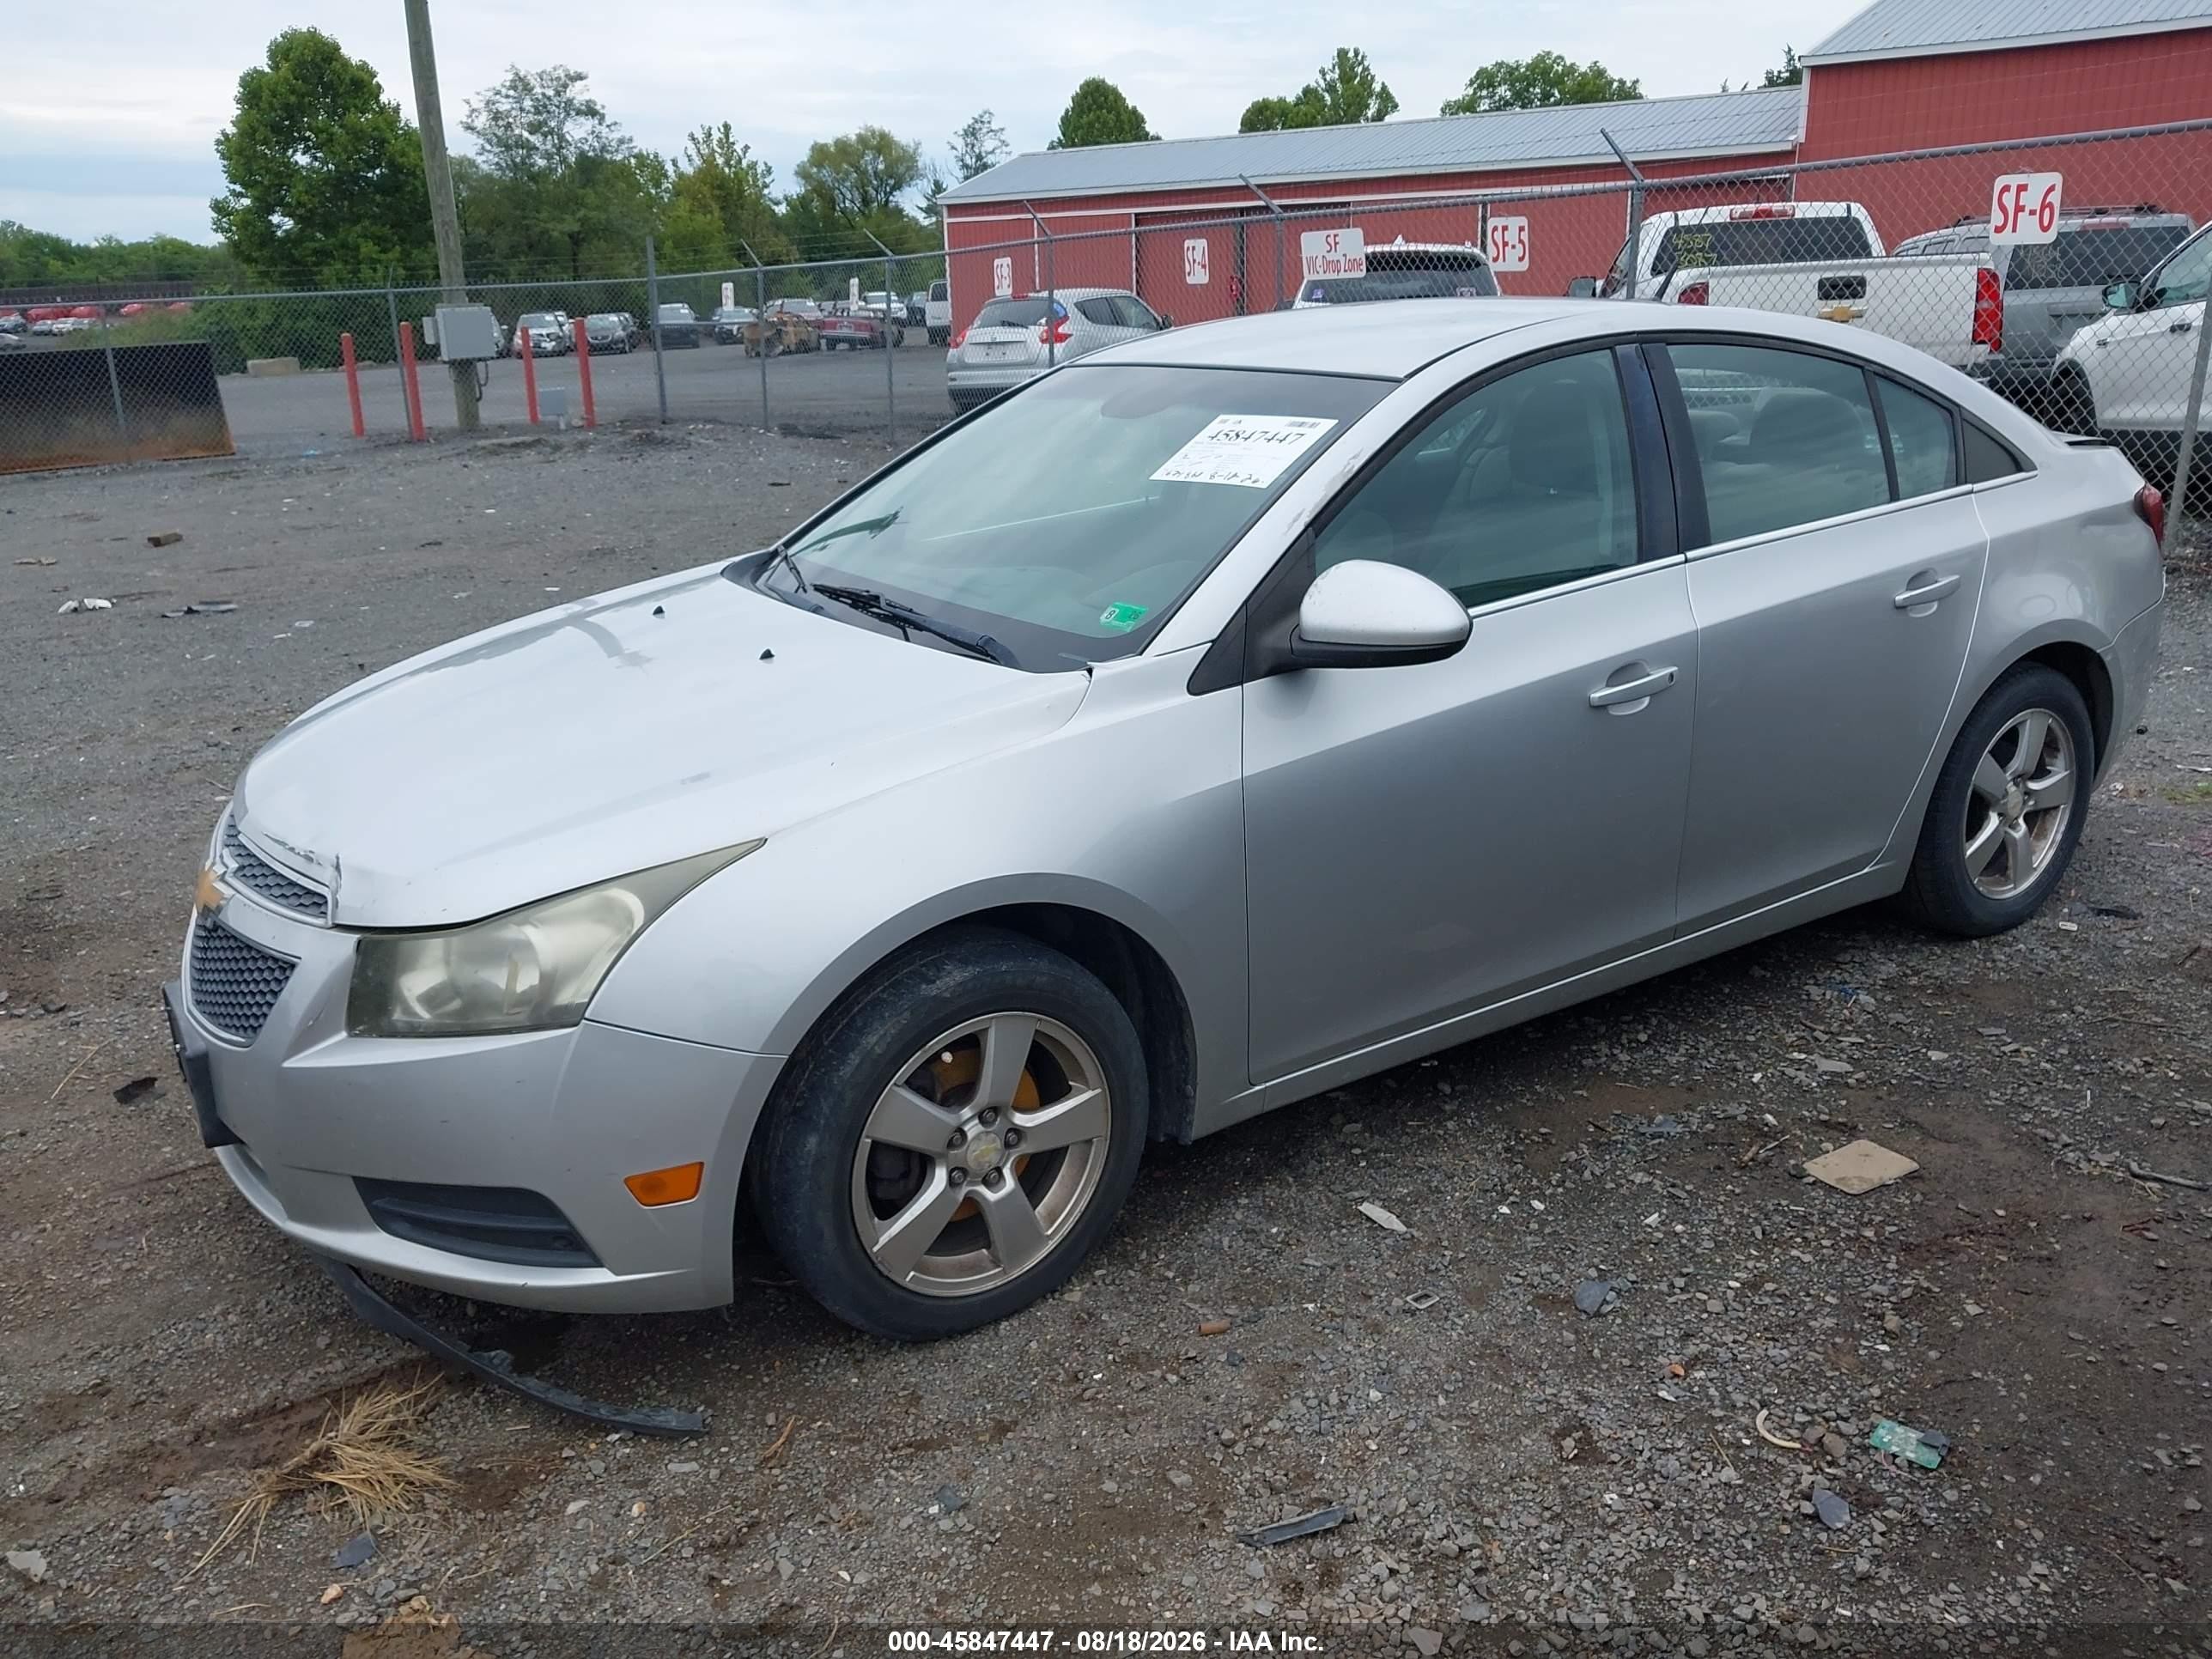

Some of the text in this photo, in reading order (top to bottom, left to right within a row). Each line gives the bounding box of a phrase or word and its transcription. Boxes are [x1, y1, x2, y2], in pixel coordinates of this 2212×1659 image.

[1993, 183, 2056, 234] SF-6
[1325, 233, 1340, 253] SF
[1491, 225, 1526, 263] SF-5
[1186, 246, 1207, 276] SF-4
[1305, 252, 1364, 276] VIC-Drop Zone
[995, 263, 1011, 290] SF-3
[1207, 429, 1306, 445] 45847447
